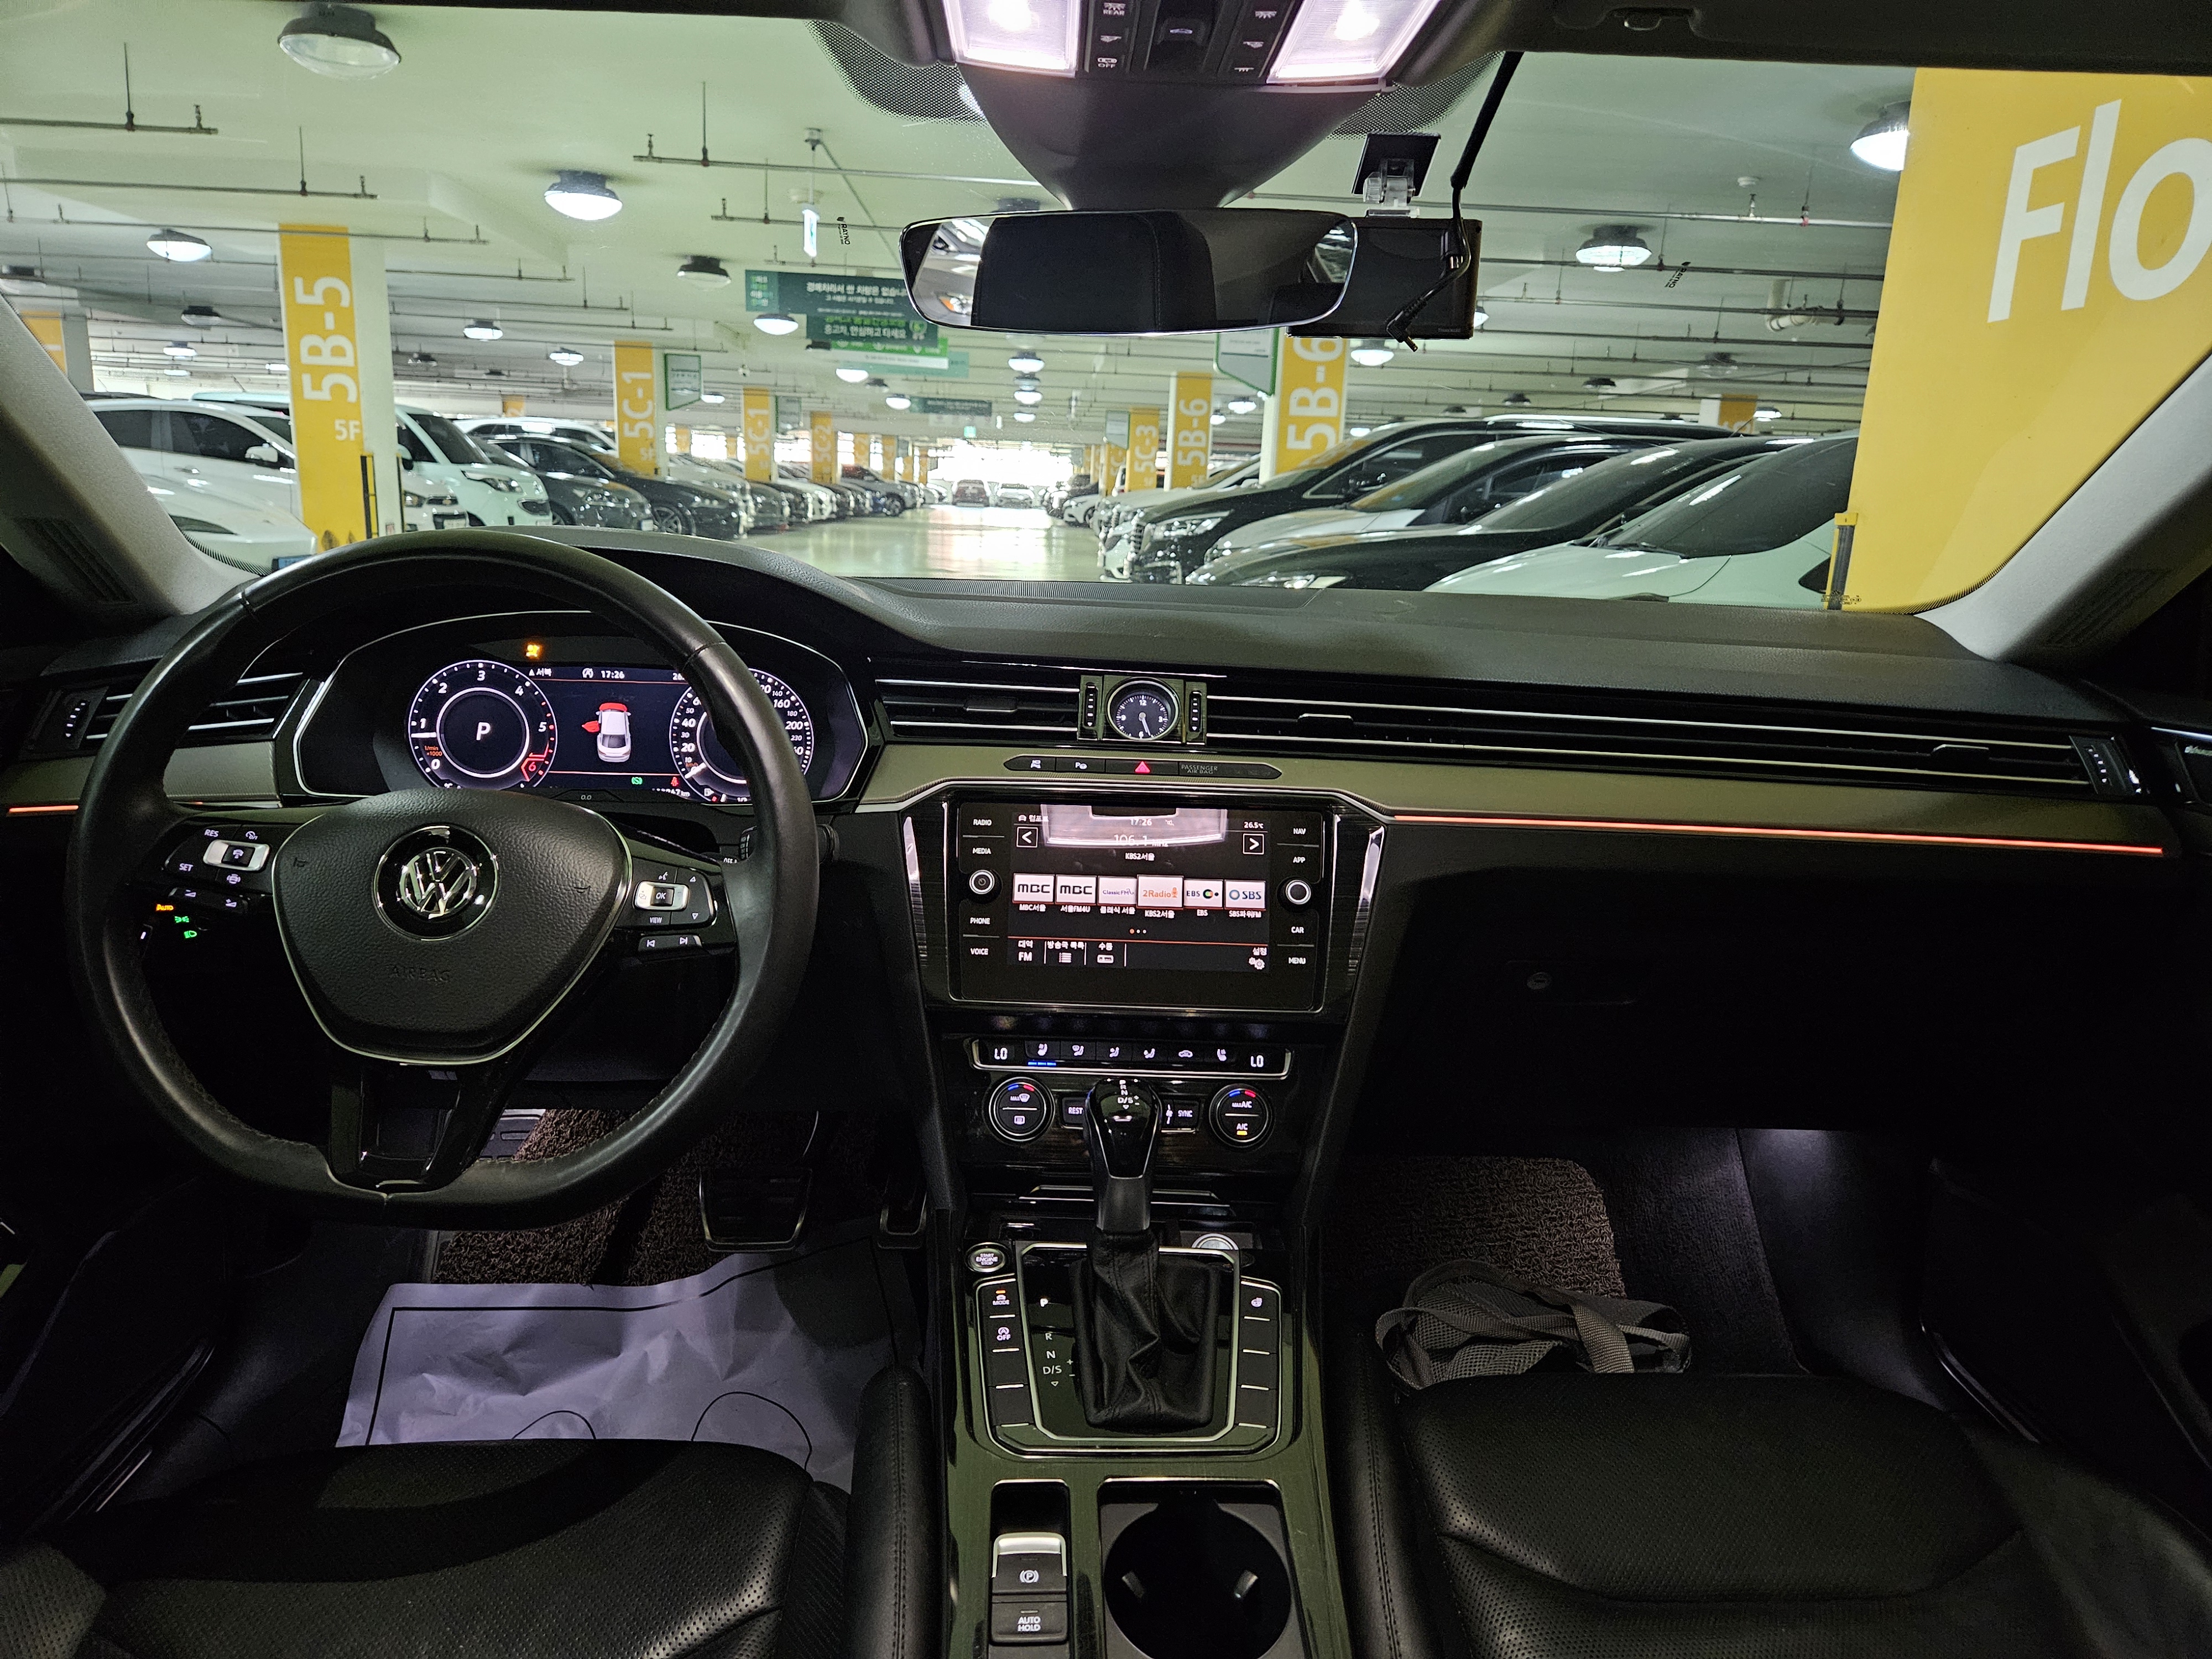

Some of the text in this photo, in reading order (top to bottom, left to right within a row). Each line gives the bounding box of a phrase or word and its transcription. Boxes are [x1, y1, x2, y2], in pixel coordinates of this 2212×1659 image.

[841, 223, 851, 245] RAYNO
[1668, 268, 1687, 288] RAYNO
[294, 276, 358, 404] 5B-5
[1286, 338, 1343, 450] 5B-6
[622, 371, 655, 439] 5C-1
[335, 419, 361, 441] 5F
[748, 408, 770, 455] 5C-1
[1178, 398, 1208, 466] 5B-6
[1134, 425, 1157, 473] 5C-3
[477, 670, 486, 681] 3
[601, 670, 625, 679] 17:26
[438, 682, 447, 693] 2
[515, 685, 524, 696] 4
[773, 699, 790, 708] 160
[420, 718, 426, 729] 1
[538, 722, 547, 732] 5
[681, 718, 696, 728] 40
[785, 721, 804, 730] 200
[476, 722, 491, 740] P
[681, 742, 695, 753] 20
[431, 759, 440, 769] 0
[528, 761, 536, 772] 6
[205, 829, 219, 837] RES
[1125, 853, 1155, 861] KBS2서울
[179, 863, 194, 872] SET
[1018, 884, 1050, 893] MBC
[1060, 885, 1093, 895] MBC
[1242, 891, 1262, 900] SBS
[1019, 904, 1046, 912] MBC서울
[1145, 910, 1175, 919] KBS2서울
[1018, 940, 1034, 948] 대역
[1047, 941, 1068, 950] 방송국
[1098, 942, 1113, 951] 수동
[1018, 952, 1032, 961] FM
[1253, 947, 1267, 956] 설정
[994, 1047, 1008, 1060] LO
[1250, 1055, 1264, 1067] LO
[1040, 1297, 1048, 1307] P
[1046, 1350, 1056, 1359] N
[1042, 1365, 1062, 1375] D/S
